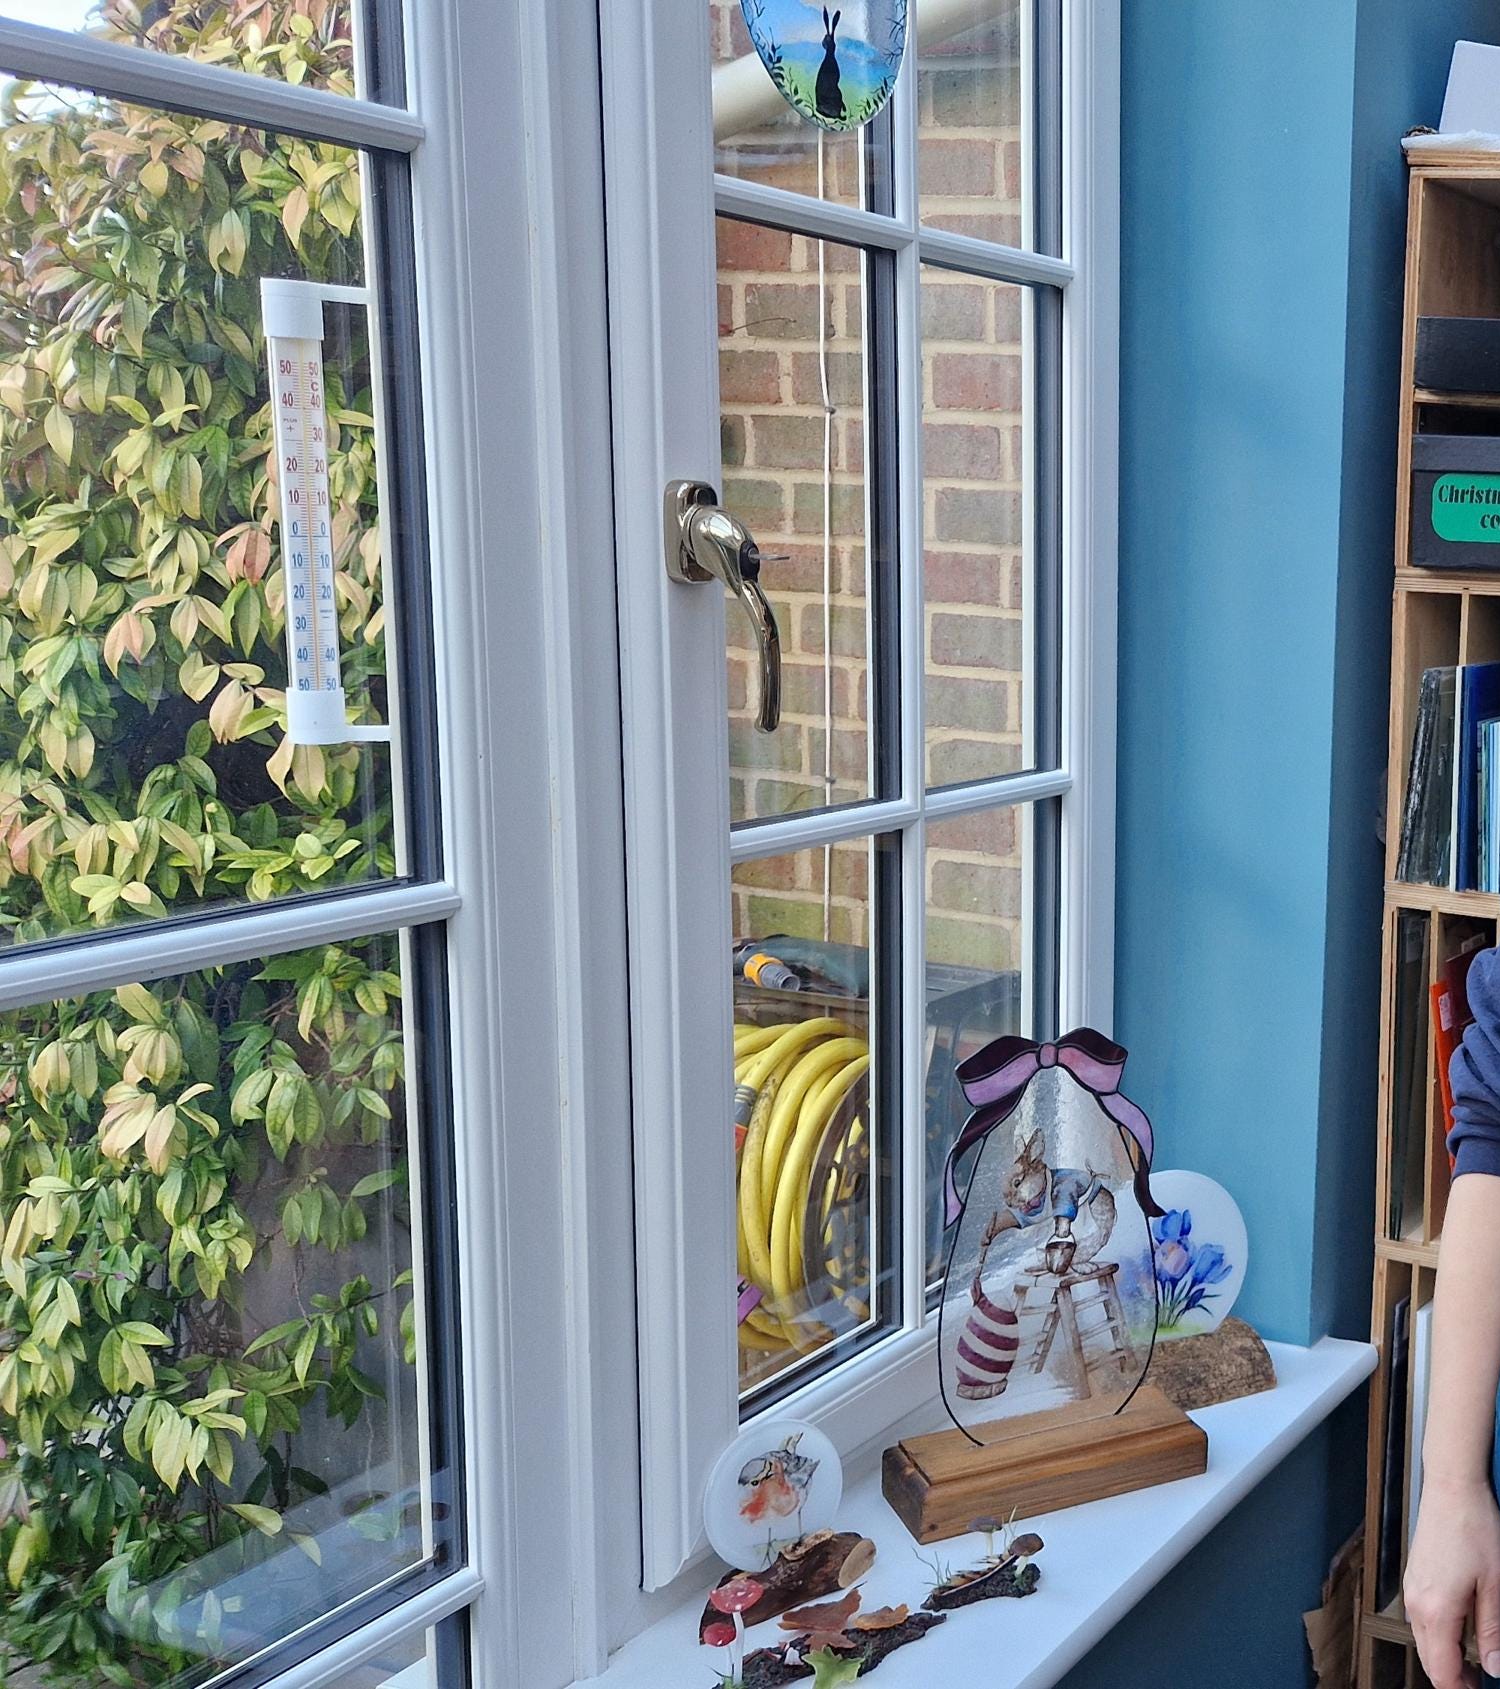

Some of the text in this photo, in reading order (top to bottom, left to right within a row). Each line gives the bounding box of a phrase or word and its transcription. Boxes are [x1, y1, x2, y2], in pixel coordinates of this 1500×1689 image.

[280, 360, 291, 374] 50
[309, 362, 318, 376] 50
[282, 393, 293, 407] 40
[311, 394, 320, 408] 40
[313, 427, 322, 441] 30
[287, 457, 297, 472] 20
[315, 459, 324, 473] 20
[289, 489, 299, 503] 10
[317, 491, 326, 504] 10
[292, 522, 298, 535] 0
[321, 522, 326, 535] 0
[292, 553, 302, 567] 10
[320, 554, 330, 567] 10
[294, 585, 304, 599] 20
[322, 585, 331, 599] 20
[295, 617, 306, 630] 30
[297, 647, 308, 661] 40
[325, 647, 335, 661] 40
[299, 678, 310, 691] 50
[326, 678, 336, 691] 50
